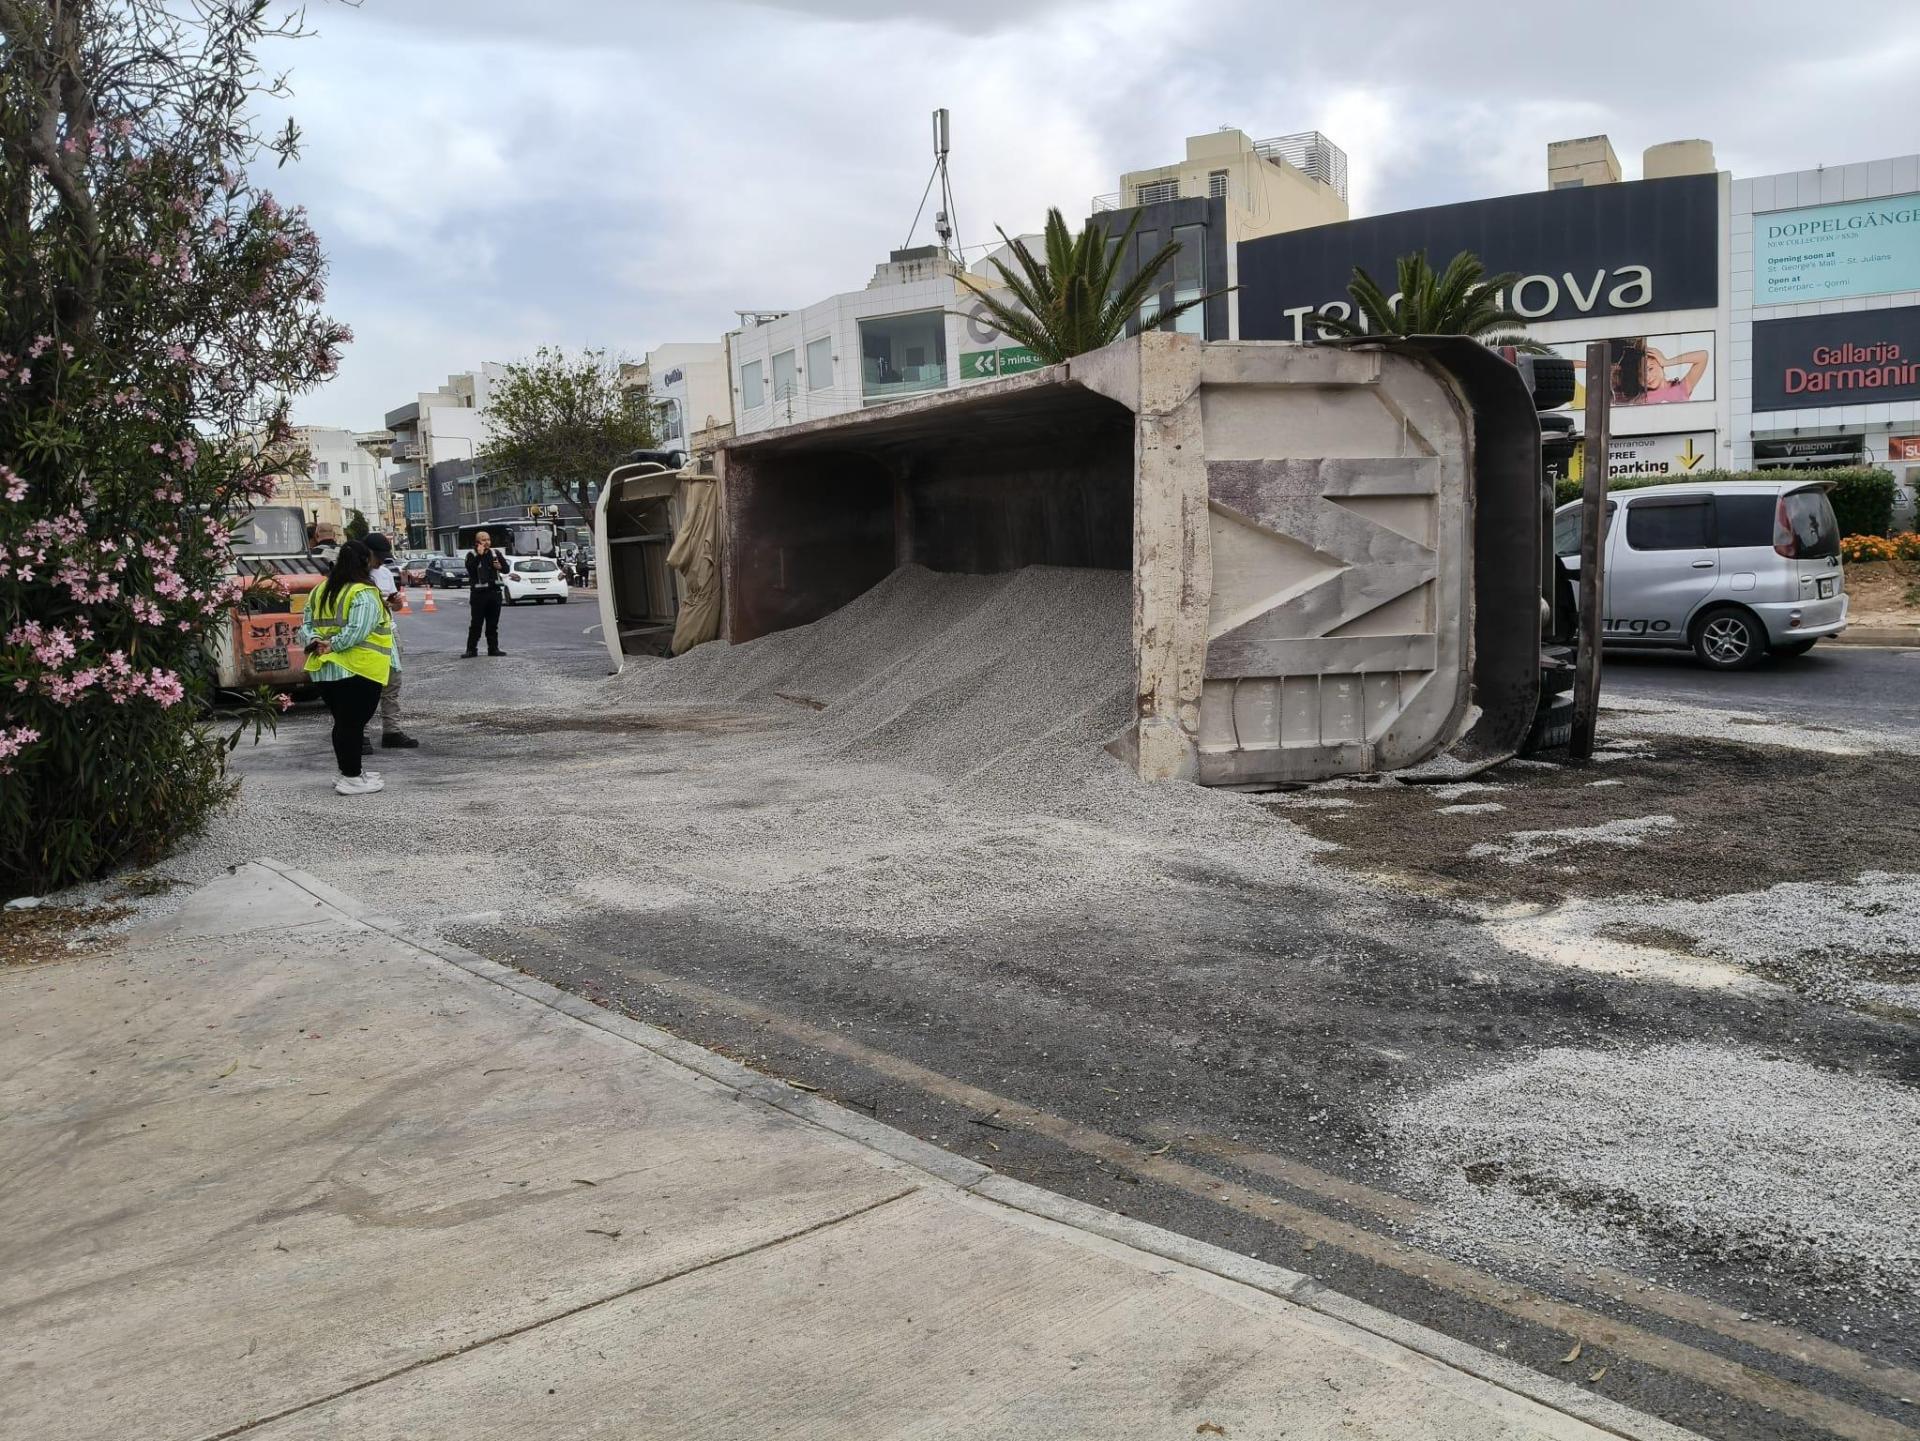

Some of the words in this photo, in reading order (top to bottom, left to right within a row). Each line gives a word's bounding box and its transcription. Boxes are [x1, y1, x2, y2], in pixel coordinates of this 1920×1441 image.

[1768, 255, 1802, 265] Opening
[1803, 253, 1824, 261] soon
[1781, 259, 1816, 271] George's
[1819, 259, 1836, 267] Mall
[1861, 254, 1892, 263] Julians
[1768, 278, 1789, 286] Open
[1768, 282, 1814, 293] Centerparc
[1824, 279, 1850, 289] Qormi
[1008, 355, 1032, 365] mins
[1813, 341, 1900, 367] Gallarija
[1795, 442, 1832, 451] macron
[1609, 450, 1636, 459] FREE
[1609, 460, 1669, 476] parking
